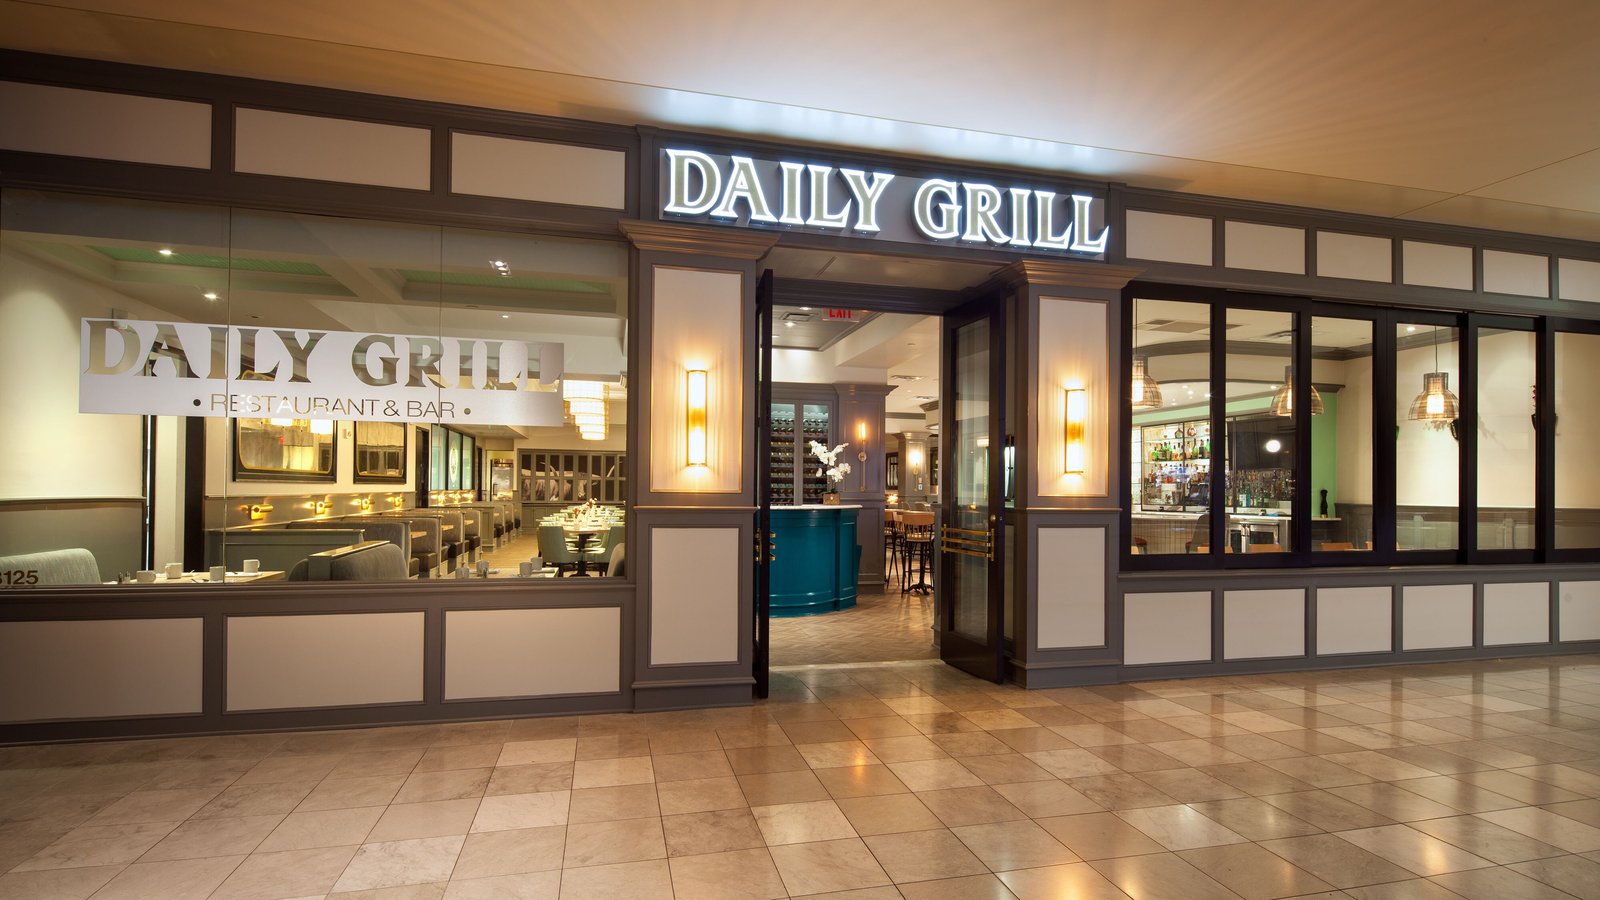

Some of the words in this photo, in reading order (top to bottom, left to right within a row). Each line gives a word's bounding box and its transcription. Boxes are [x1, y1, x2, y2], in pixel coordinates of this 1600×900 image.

[665, 148, 895, 232] DAILY
[914, 179, 1110, 253] GRILL
[83, 319, 327, 383] DAILY
[351, 334, 562, 392] GRILL
[211, 394, 380, 417] RESTAURANT
[384, 400, 400, 417] &
[406, 402, 456, 419] BAR
[0, 570, 39, 585] 125
